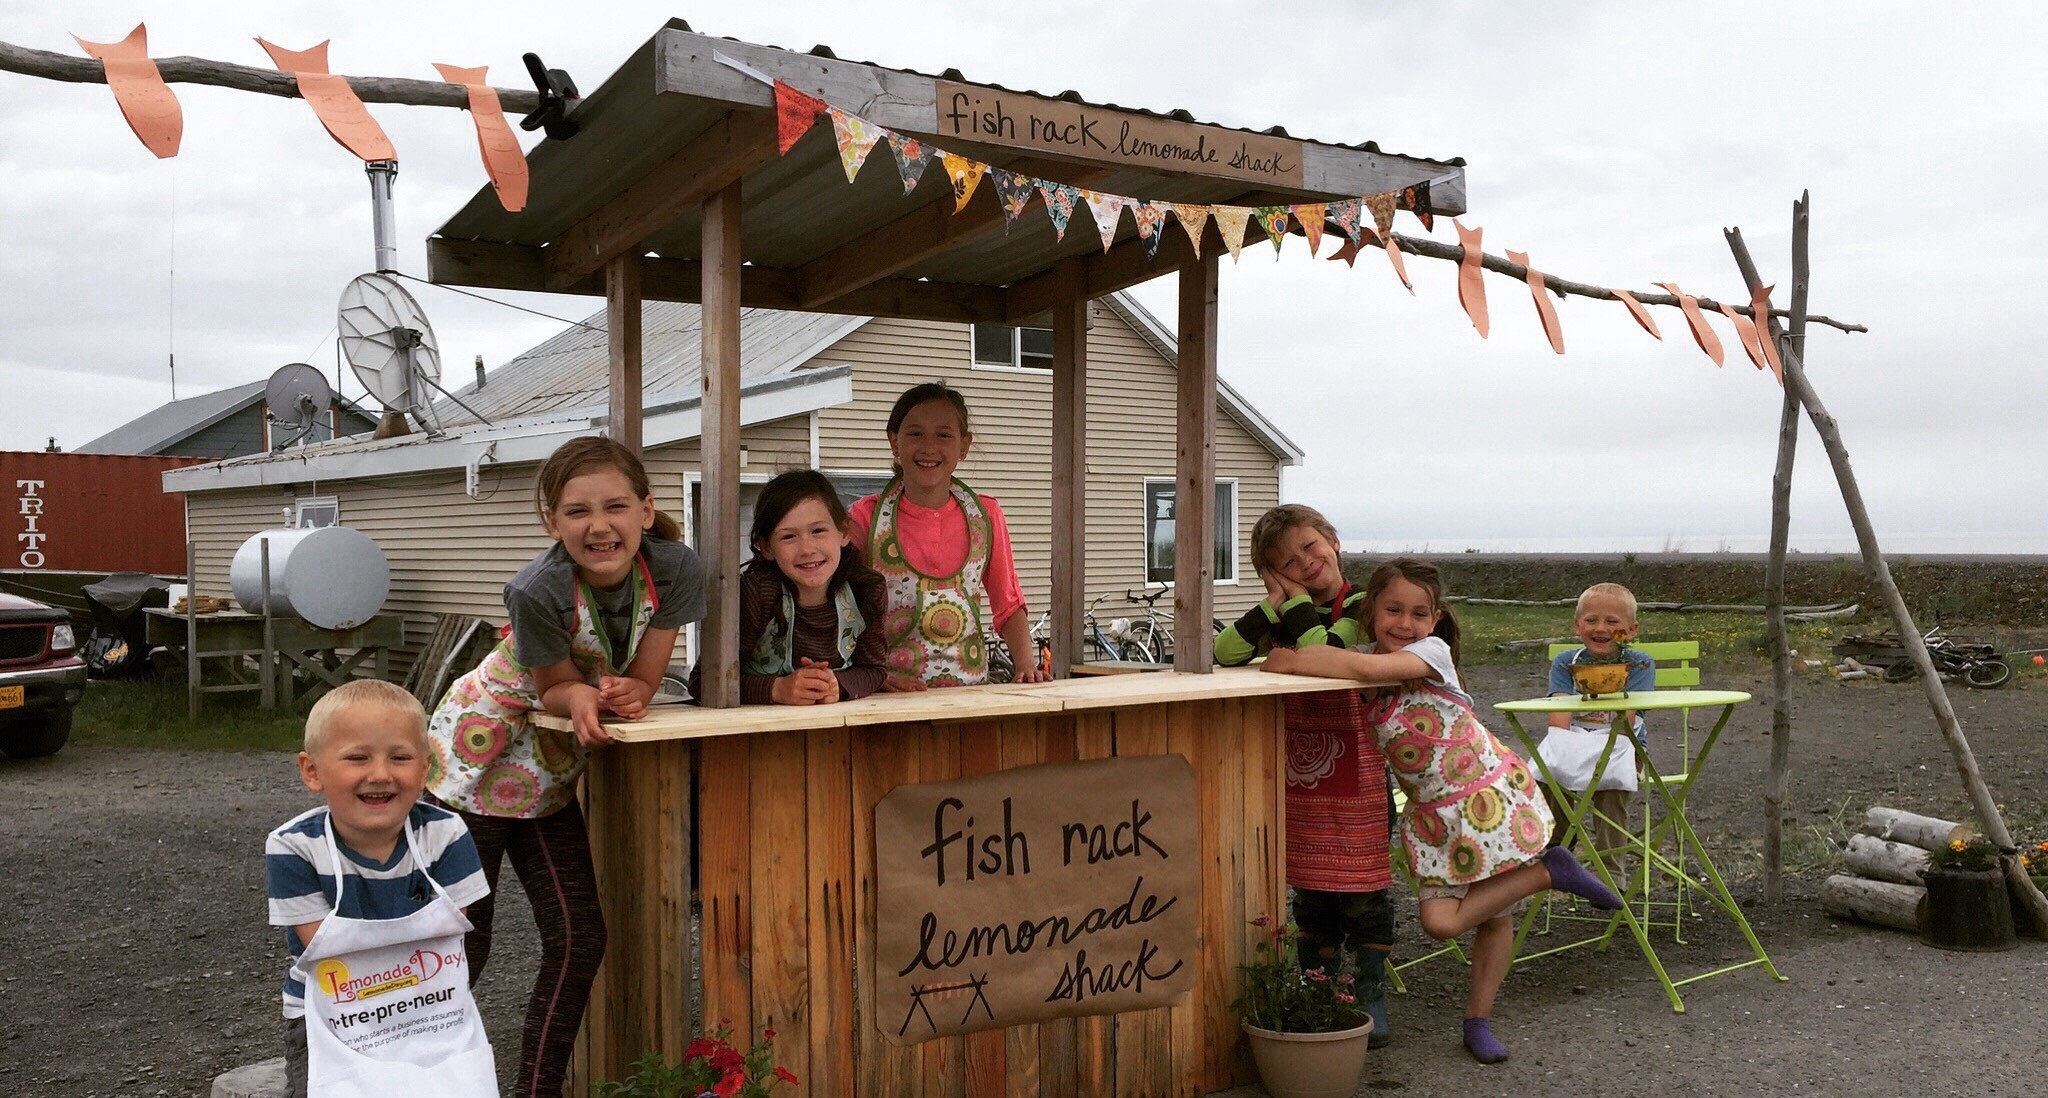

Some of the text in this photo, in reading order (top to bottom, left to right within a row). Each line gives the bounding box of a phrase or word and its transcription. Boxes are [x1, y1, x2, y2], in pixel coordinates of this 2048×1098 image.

[946, 93, 1296, 173] fish rack lemonade shack
[920, 797, 1169, 887] fish rack
[898, 876, 1178, 977] lemonade
[326, 964, 411, 1005] Lemonade
[1045, 939, 1183, 1003] shack
[361, 1043, 374, 1052] the
[374, 1034, 401, 1050] purpose
[401, 1029, 411, 1039] of
[411, 1023, 438, 1036] making
[369, 1027, 390, 1040] starts
[397, 1017, 429, 1030] business
[430, 1008, 465, 1022] assuming
